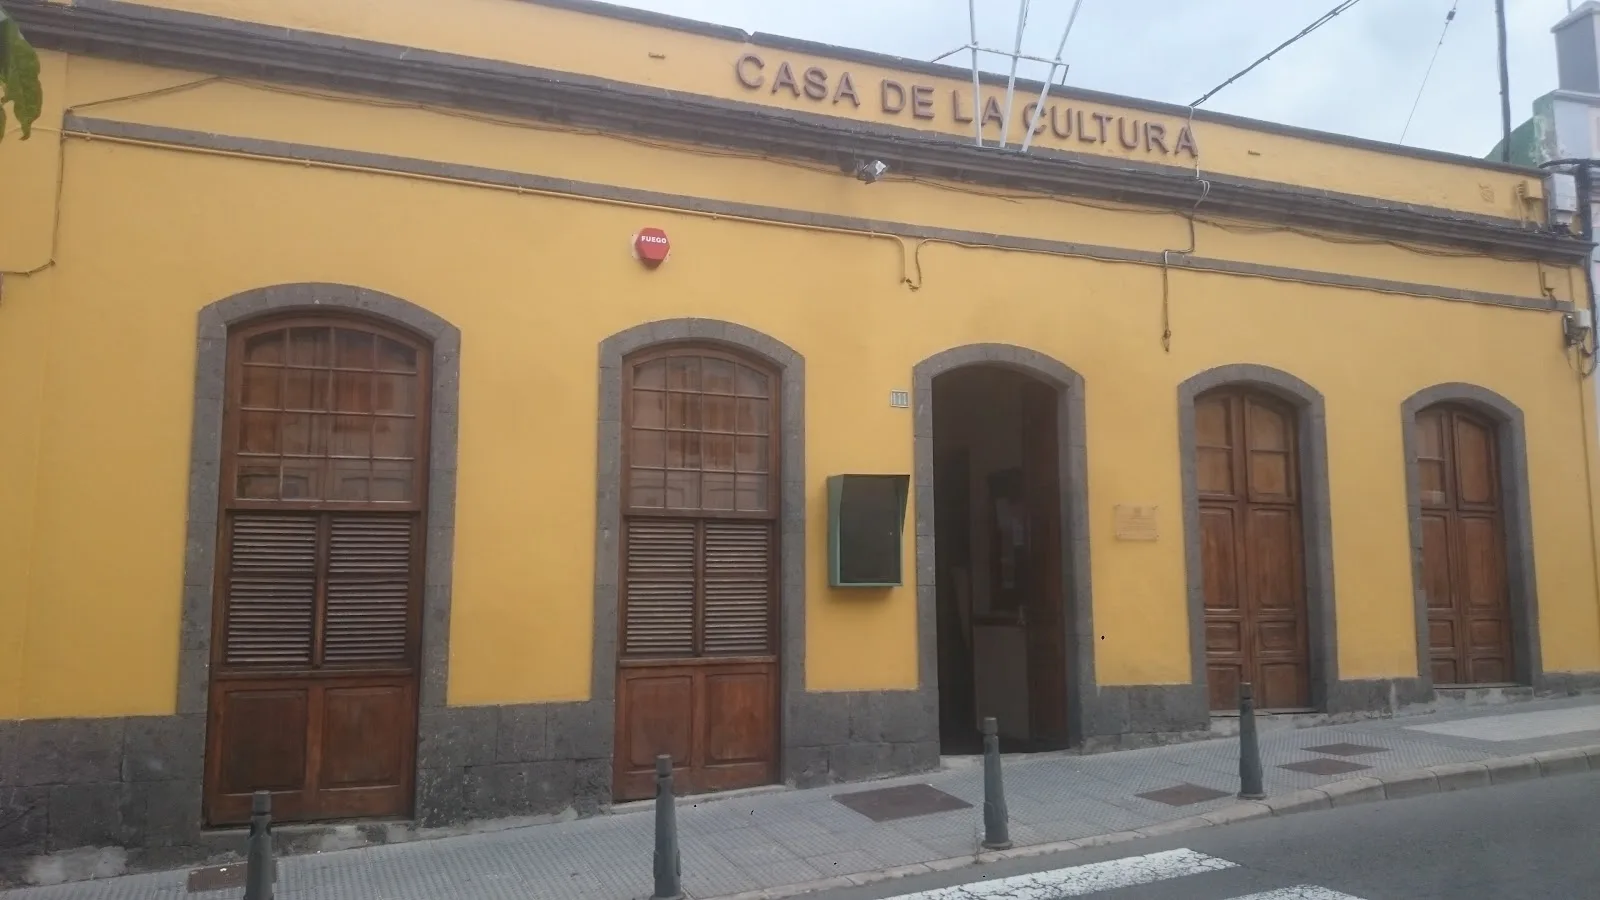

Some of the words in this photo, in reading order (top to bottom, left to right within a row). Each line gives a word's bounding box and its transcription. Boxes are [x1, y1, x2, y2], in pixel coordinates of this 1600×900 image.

[736, 54, 861, 107] CASA
[882, 79, 935, 119] DE
[953, 90, 1004, 129] LA
[1023, 101, 1199, 157] CULTURA
[641, 235, 667, 244] FUEGO
